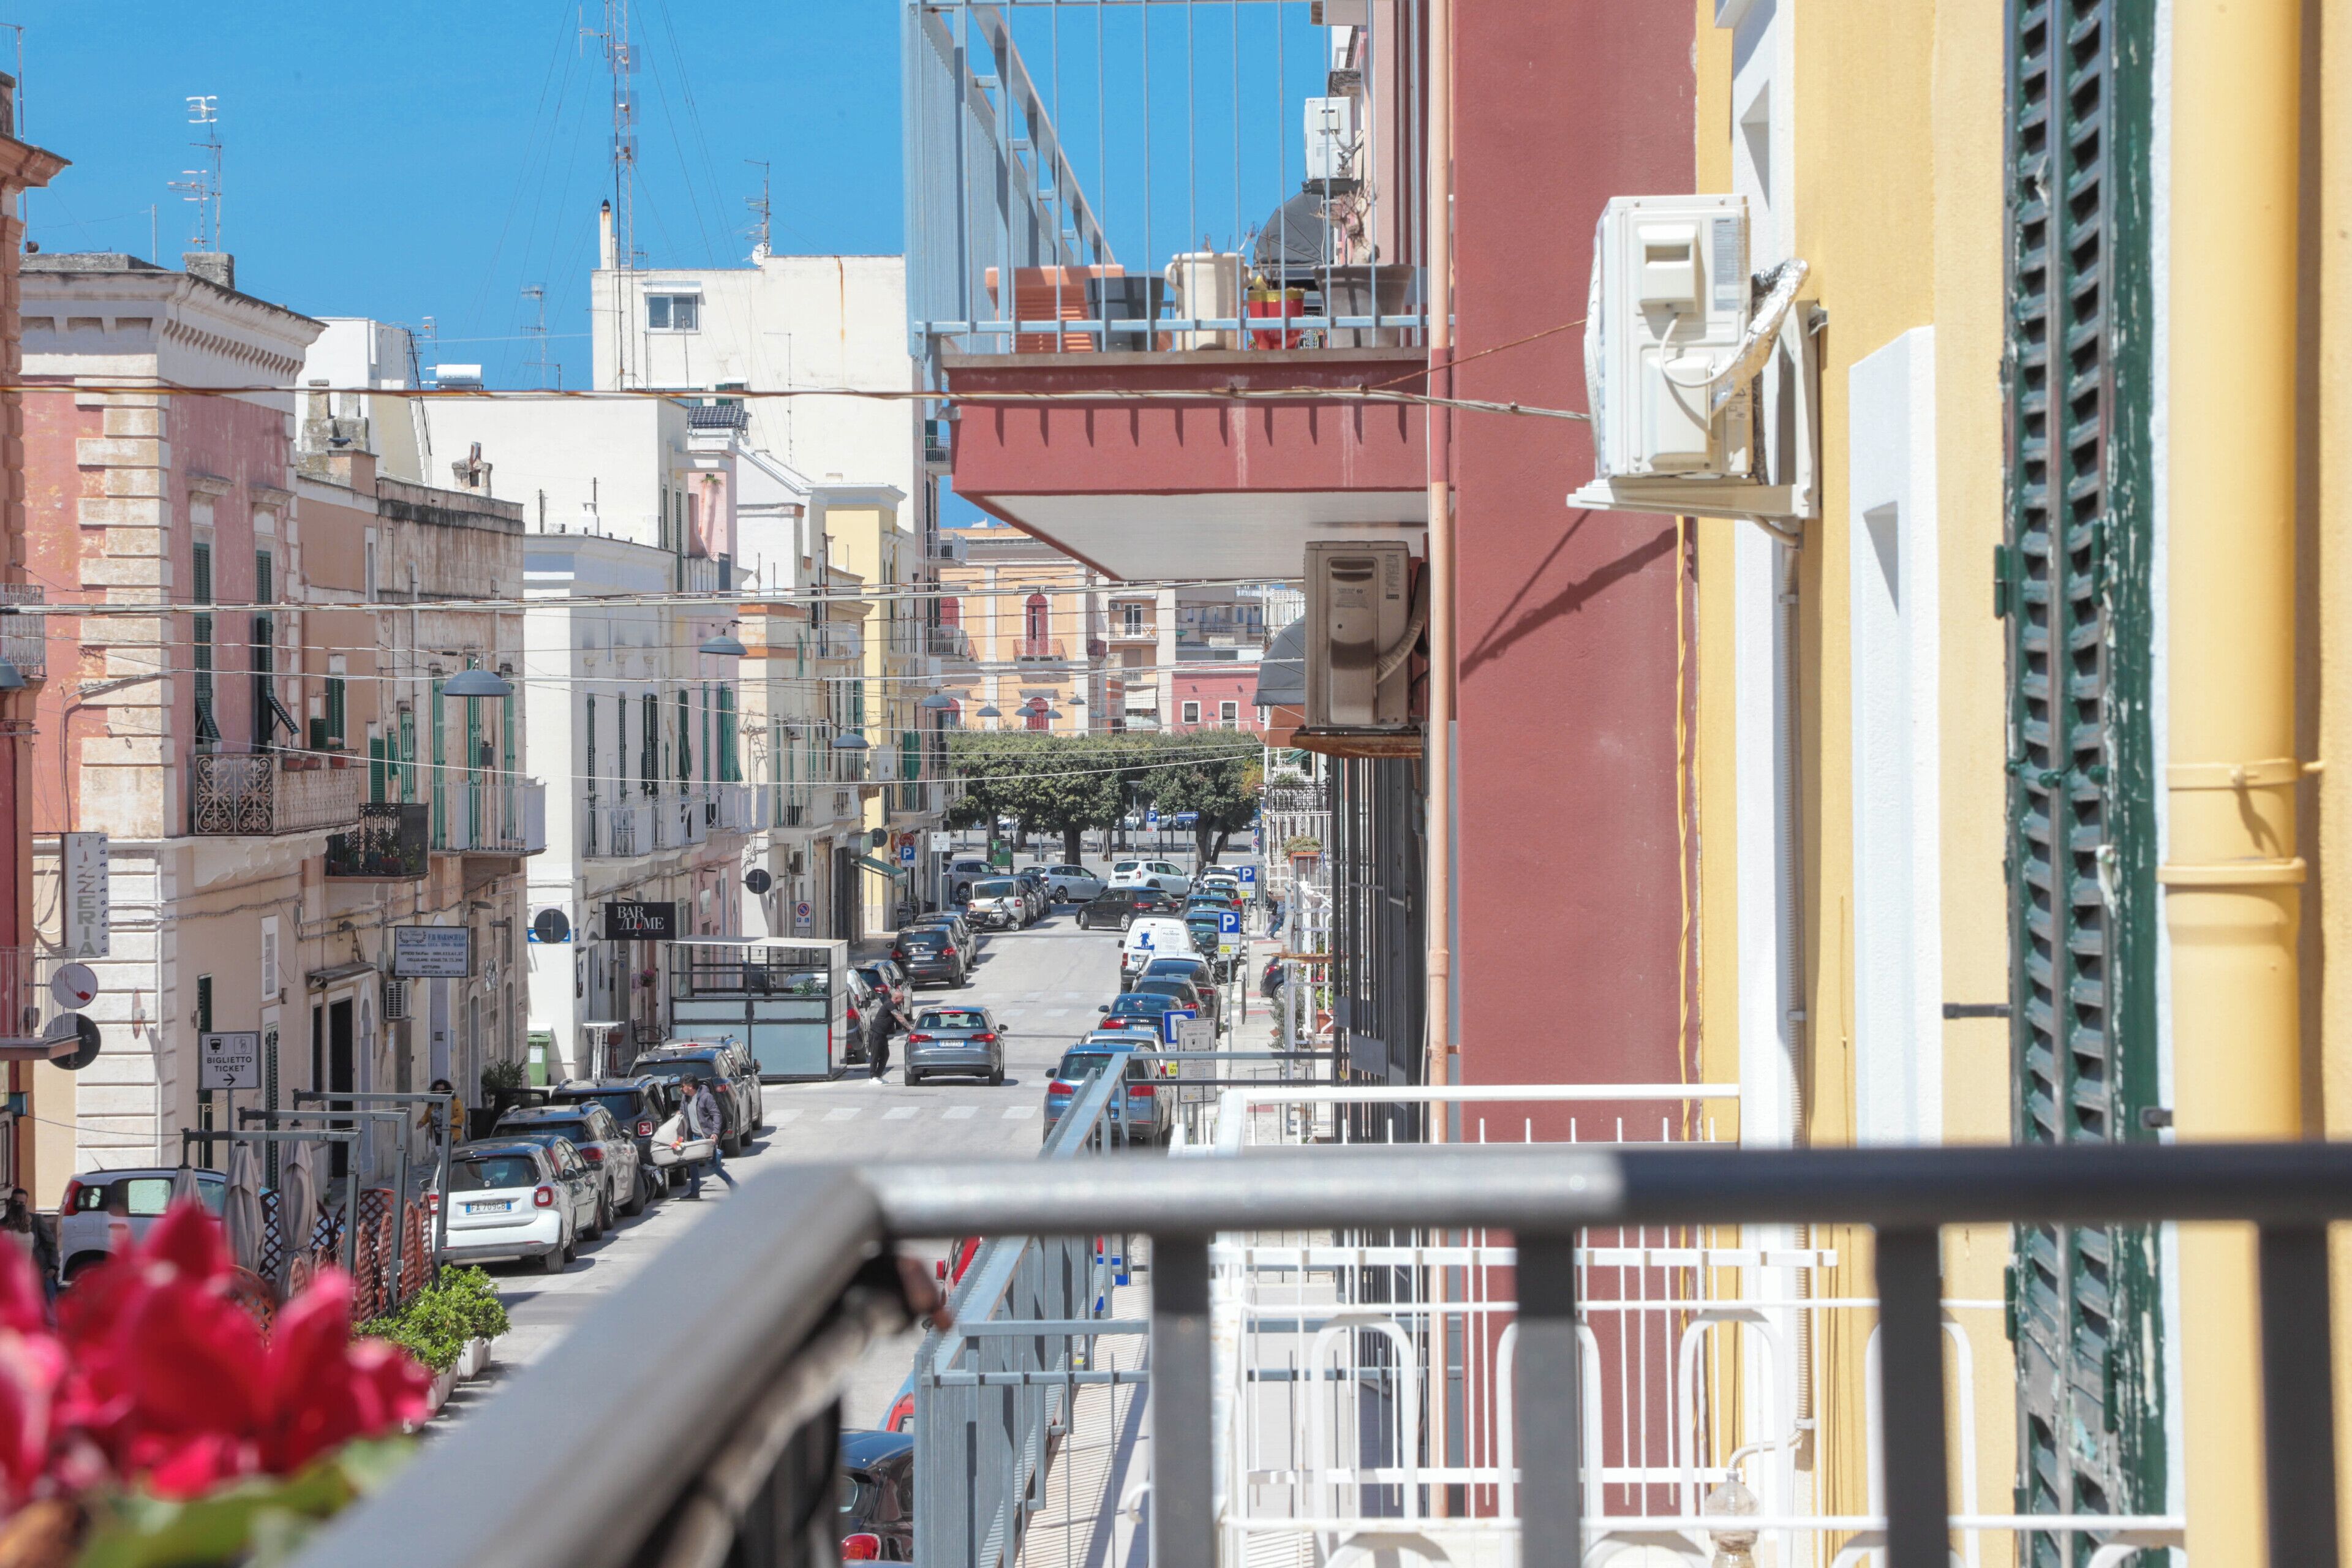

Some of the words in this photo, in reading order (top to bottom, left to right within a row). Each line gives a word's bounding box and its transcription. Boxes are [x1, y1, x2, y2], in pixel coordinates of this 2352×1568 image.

[903, 848, 911, 859] P
[1243, 868, 1252, 881] P
[617, 906, 644, 919] BAR
[1223, 914, 1235, 932] P
